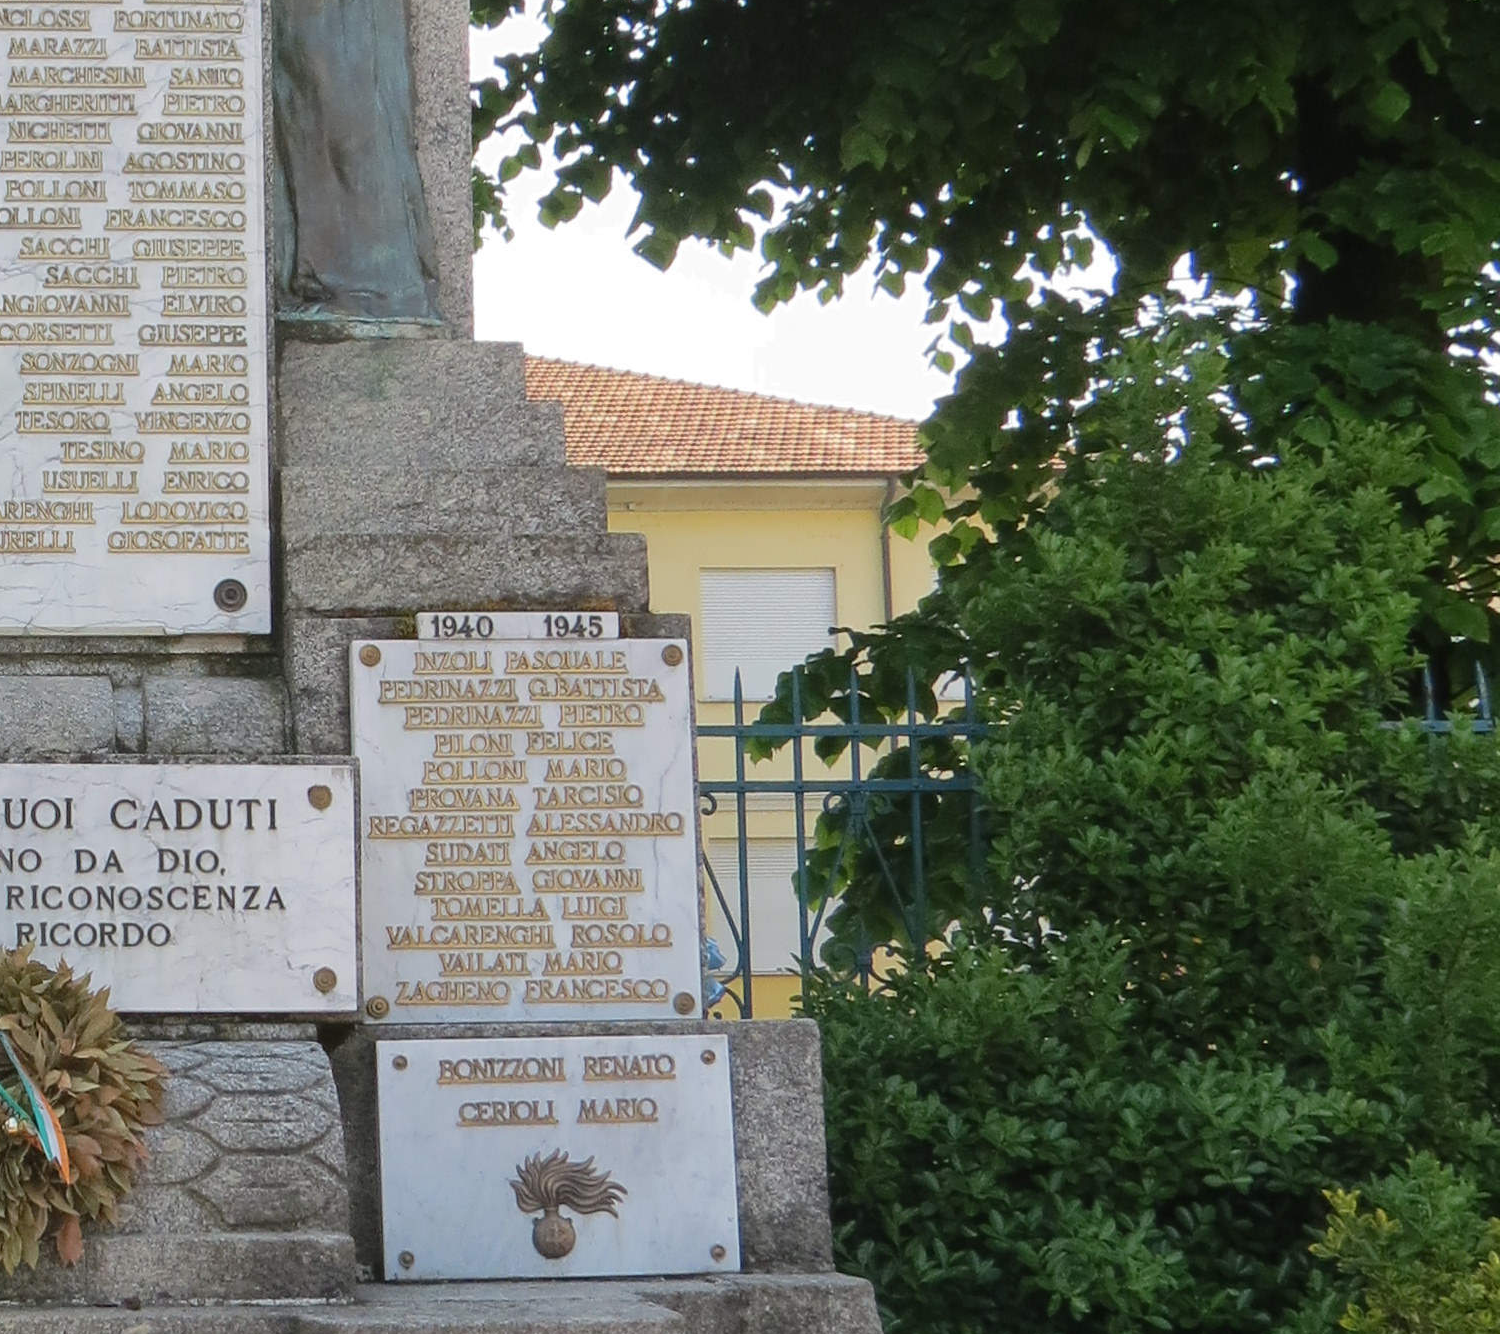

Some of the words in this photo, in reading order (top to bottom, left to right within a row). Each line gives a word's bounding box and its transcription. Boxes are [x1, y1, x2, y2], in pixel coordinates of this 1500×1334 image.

[104, 209, 246, 231] FRANCESCO
[43, 266, 140, 288] SACCHI
[161, 267, 246, 288] PIETRO
[161, 295, 246, 317] ELVIRO
[22, 383, 126, 405] SPINELLI
[151, 383, 249, 405] ANGELO
[42, 471, 139, 493] USUELLI
[162, 471, 249, 493] ENRICO
[107, 531, 250, 553] GIOSOFATTE
[431, 616, 493, 637] 1940
[544, 616, 603, 637] 1945
[413, 651, 492, 674] INZOLI
[504, 651, 628, 674] PASQUALE
[378, 680, 518, 703] PEDRINAZZI
[404, 706, 543, 729] PEDRINAZZI
[559, 704, 644, 726] PIETRO
[433, 734, 514, 757] PILONI
[526, 732, 614, 754] FELICE
[422, 761, 528, 784] POLLONI
[544, 759, 627, 782] MARIO
[410, 788, 520, 811] PROVANA
[533, 786, 644, 809] TARCISIO
[110, 799, 277, 831] CADUTI
[368, 816, 515, 839] REGAZZETTI
[526, 813, 684, 836] ALESSANDRO
[75, 849, 124, 874] DA
[158, 850, 226, 876] DIO,
[425, 842, 511, 865] SUDATI
[525, 841, 625, 864] ANGELO
[414, 871, 521, 894] STROPPA
[532, 869, 644, 892] GIOVANNI
[6, 885, 286, 911] RICONOSCENZA
[431, 898, 550, 921] TOMELLA
[561, 897, 628, 919] LUIGI
[16, 923, 172, 947] RICORDO
[386, 926, 556, 949] VALCARENGHI
[571, 924, 672, 947] ROSOLO
[439, 952, 531, 976] VAILATI
[542, 951, 623, 975] MARIO
[395, 981, 511, 1005] ZAGHENO
[523, 979, 670, 1003] FRANCESCO
[438, 1057, 566, 1084] BONIZZONI
[583, 1054, 676, 1081] RENATO
[457, 1100, 559, 1126] CERIOLI
[577, 1098, 658, 1124] MARIO
